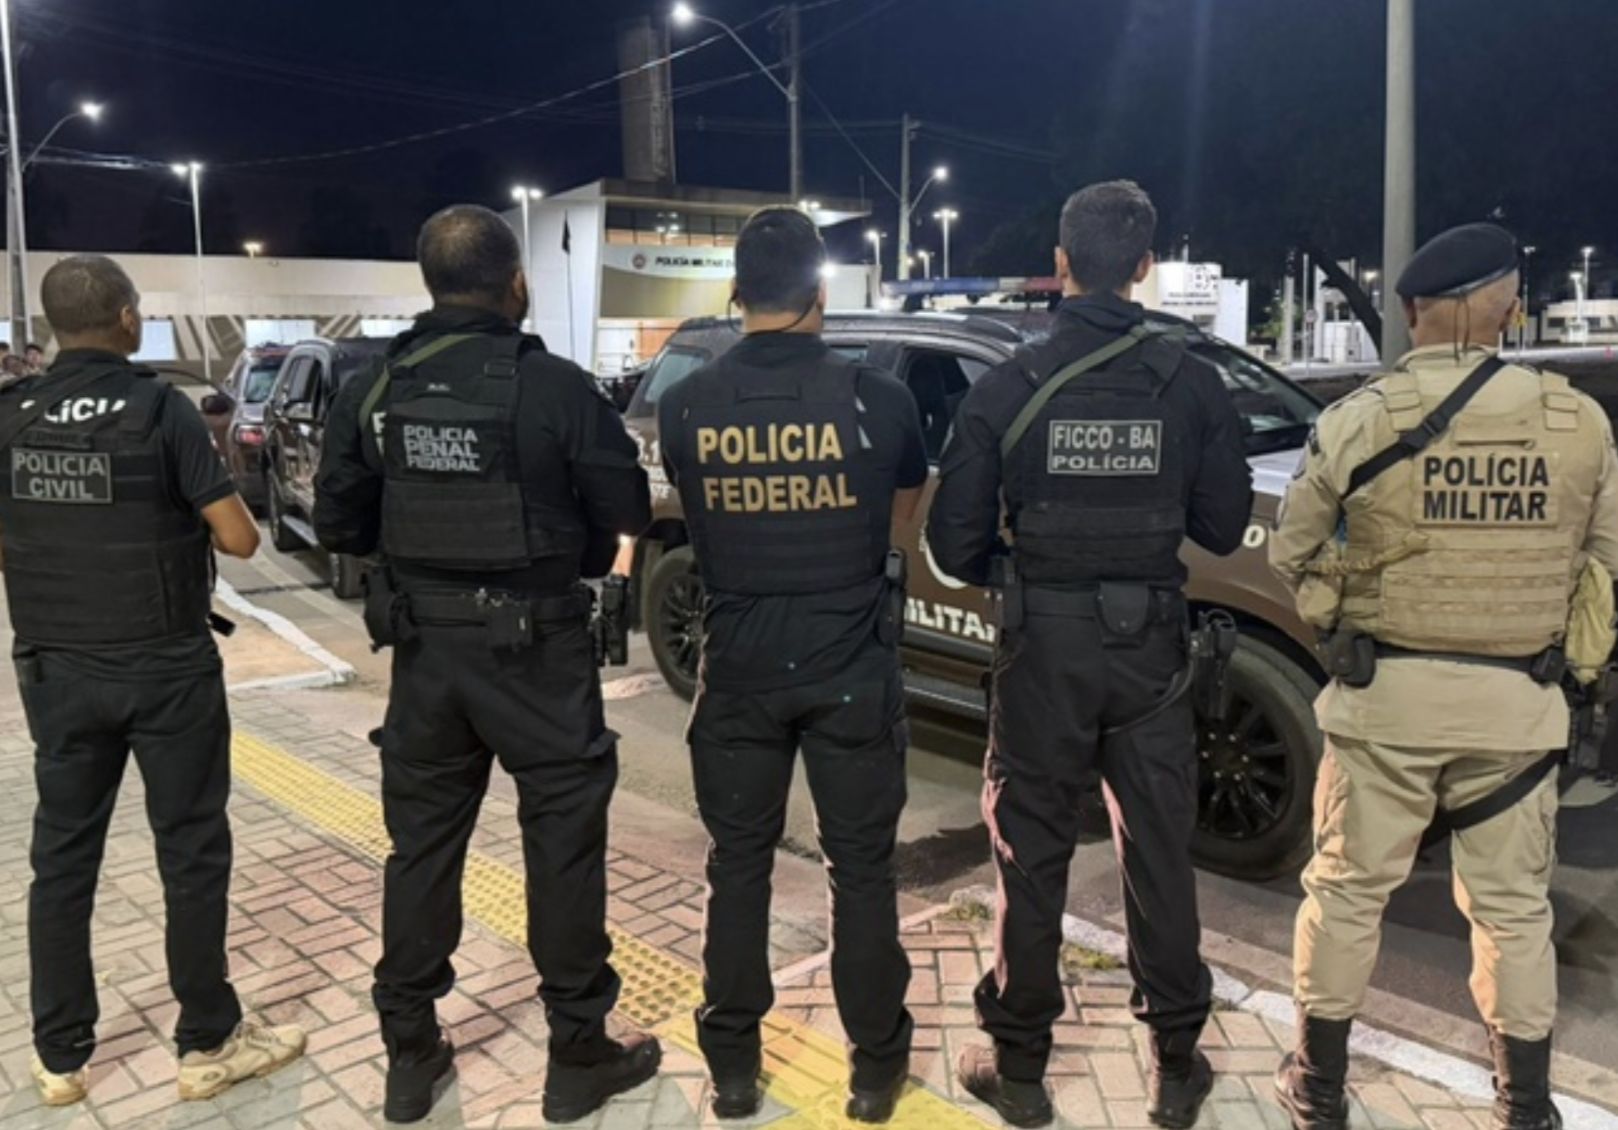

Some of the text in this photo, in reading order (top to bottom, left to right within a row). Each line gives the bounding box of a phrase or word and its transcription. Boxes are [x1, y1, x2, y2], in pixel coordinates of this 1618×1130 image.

[405, 439, 480, 459] PENAL
[1054, 425, 1113, 450] FICCO
[1129, 426, 1155, 449] BA
[407, 455, 480, 471] FEDERAL
[1052, 453, 1154, 470] POLÍCIA
[1424, 453, 1549, 487] POLÍCIA
[28, 476, 94, 499] CIVIL
[702, 472, 858, 512] FEDERAL
[1423, 490, 1548, 521] MILITAR
[903, 596, 996, 643] ILITA
